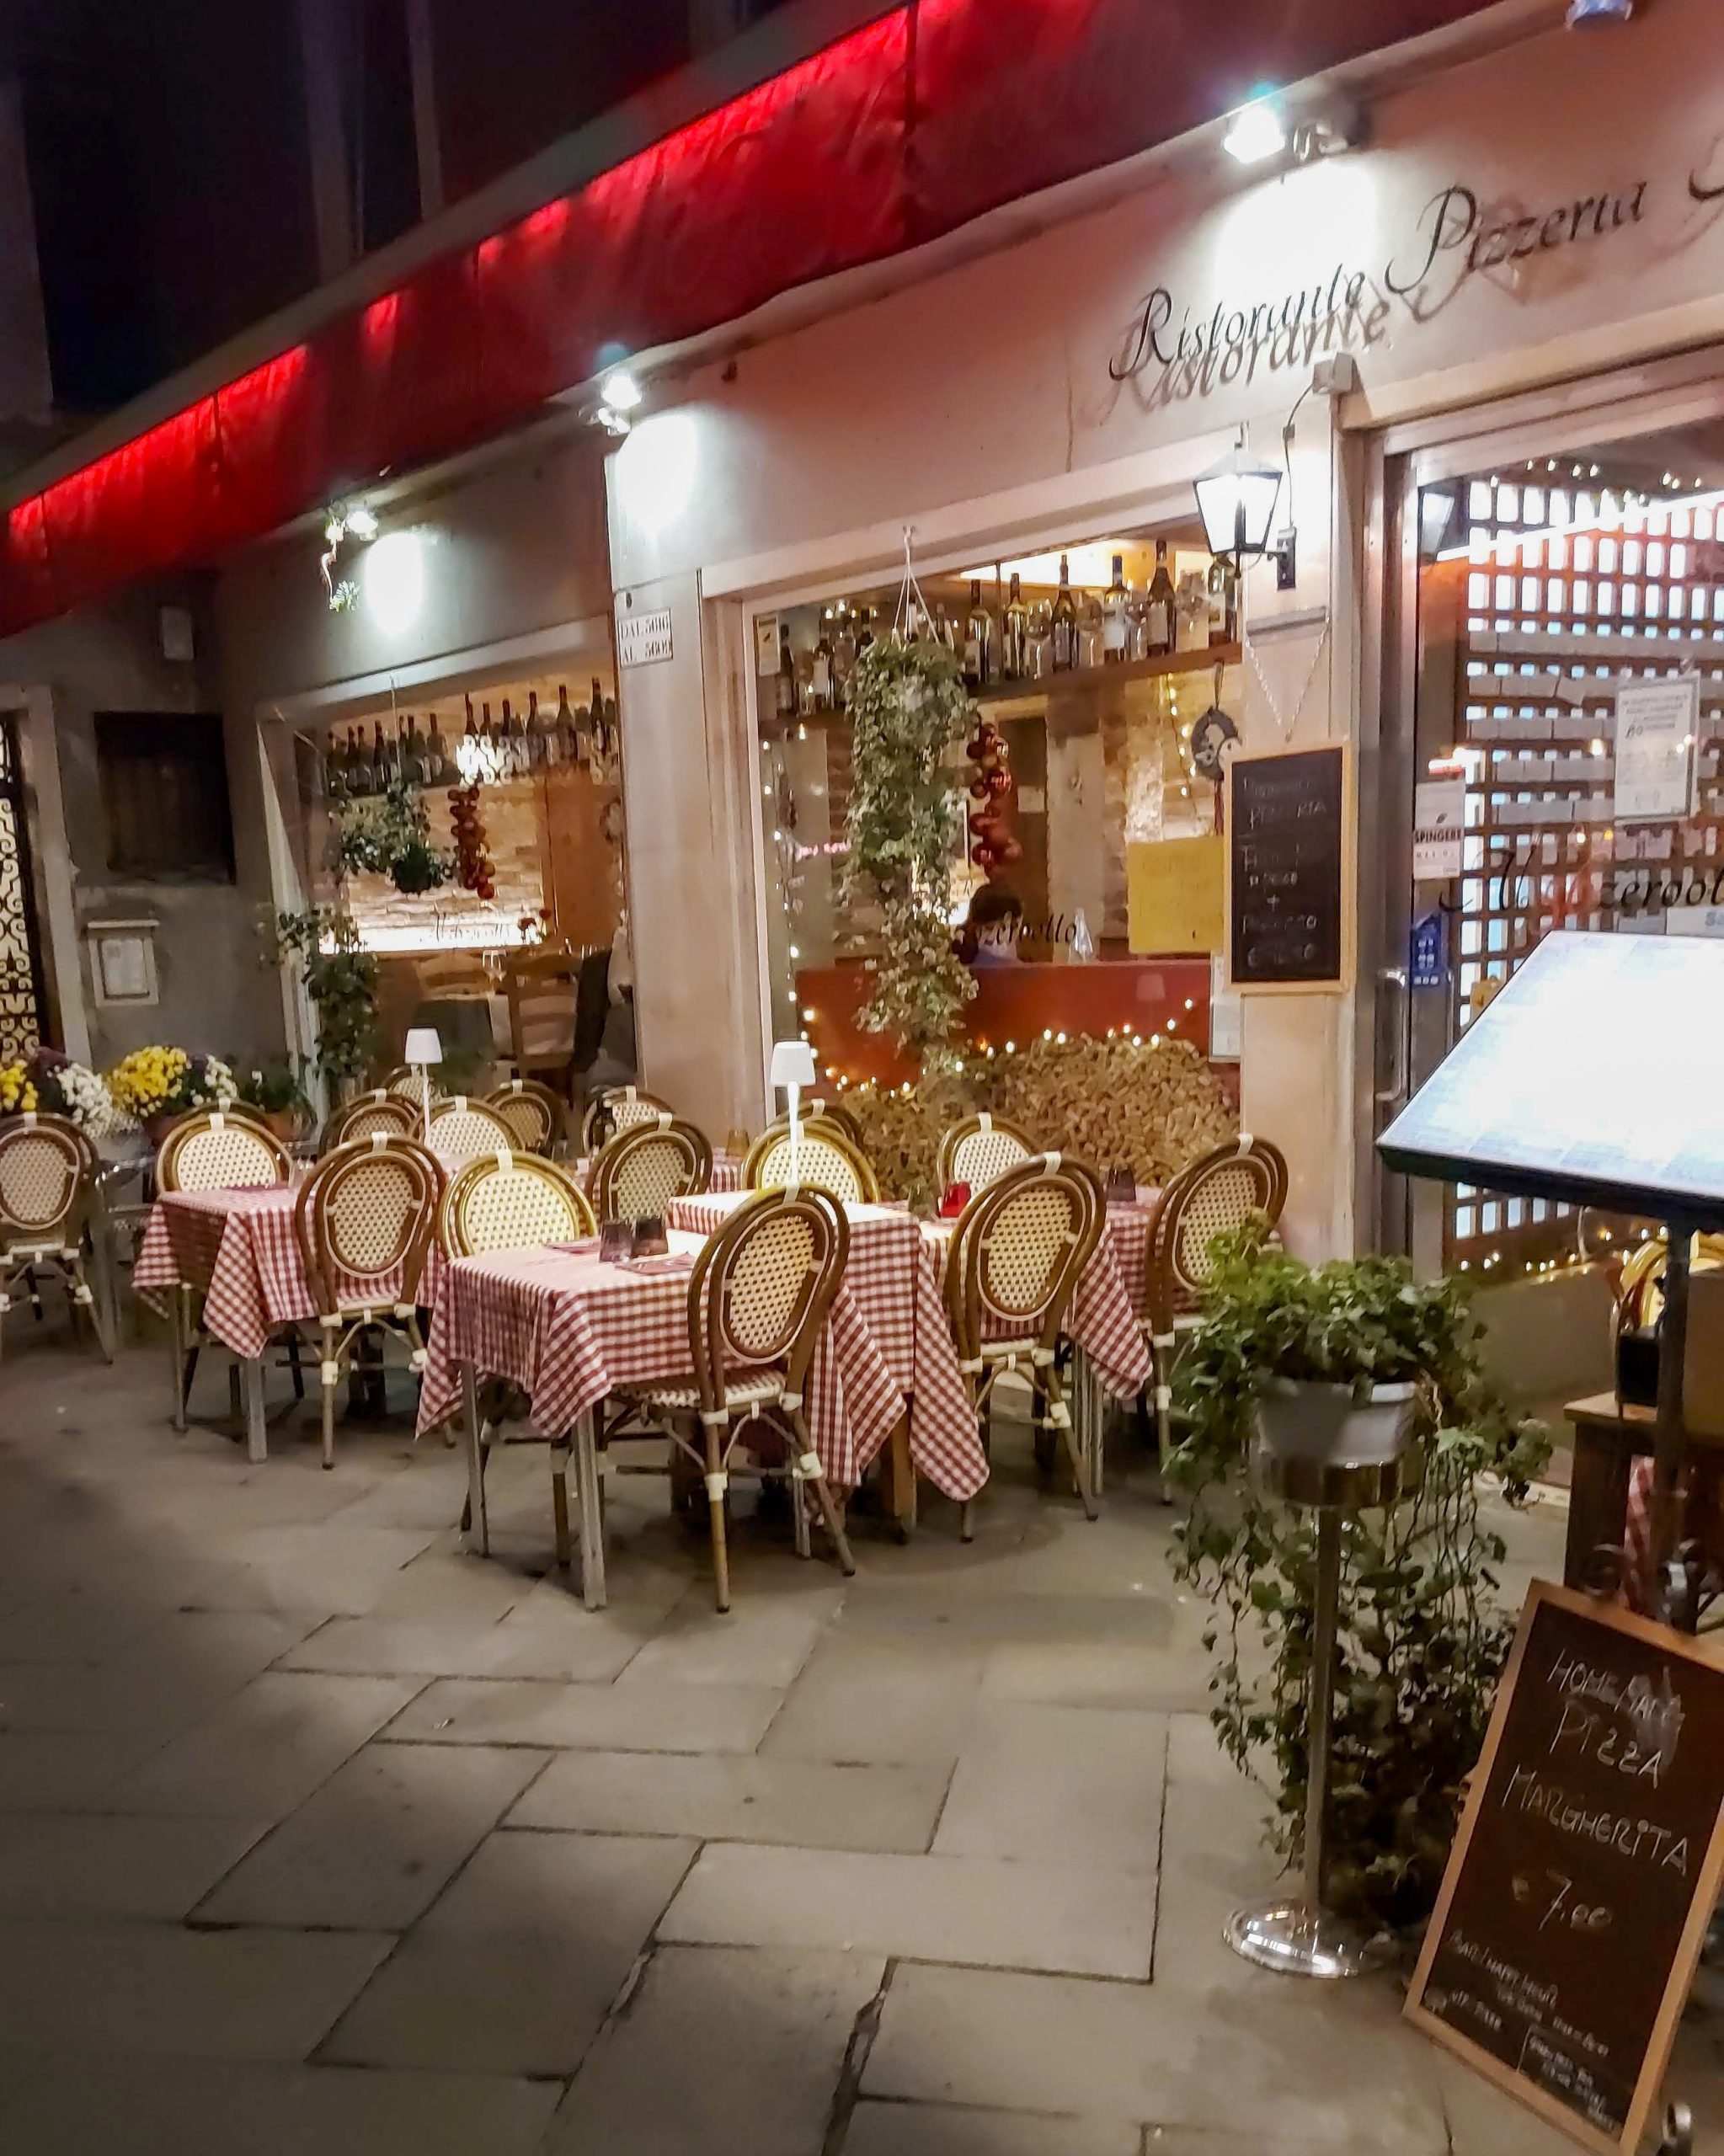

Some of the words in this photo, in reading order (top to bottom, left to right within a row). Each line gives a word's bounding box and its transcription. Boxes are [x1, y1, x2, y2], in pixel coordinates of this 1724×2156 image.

[1109, 264, 1366, 381] Ristorante
[1384, 180, 1647, 292] Pizzeria
[621, 621, 644, 640] DAL
[622, 644, 638, 663] AL
[1549, 1698, 1663, 1790] PIZZA
[1502, 1763, 1689, 1878] MARGHERITA
